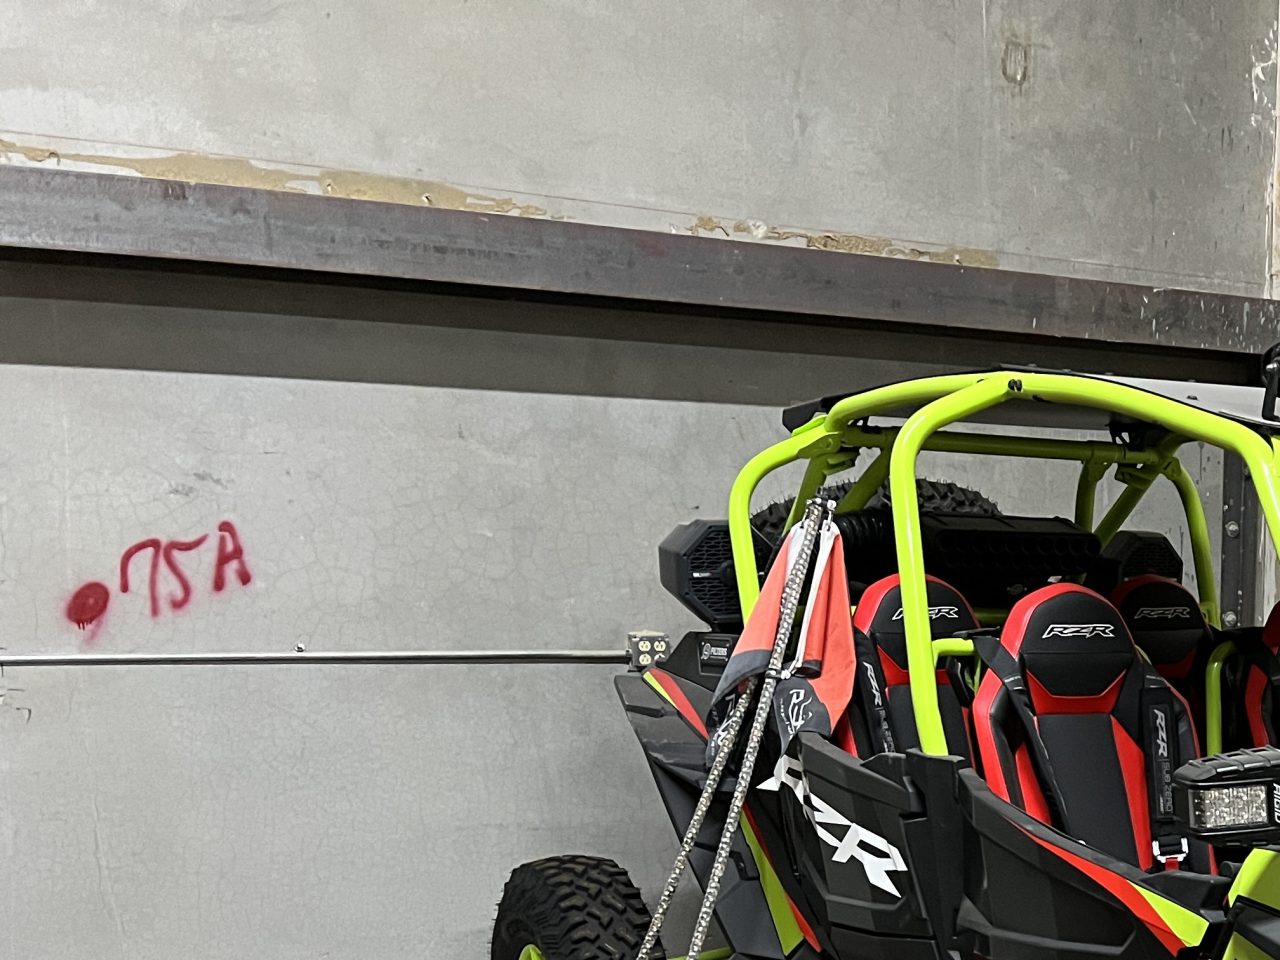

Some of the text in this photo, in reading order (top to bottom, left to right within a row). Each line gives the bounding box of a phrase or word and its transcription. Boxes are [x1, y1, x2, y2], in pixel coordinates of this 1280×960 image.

[1042, 624, 1116, 639] RZR
[1134, 607, 1191, 620] RZR
[862, 661, 883, 707] RZR
[1153, 708, 1169, 759] RZR
[755, 754, 909, 899] RZR
